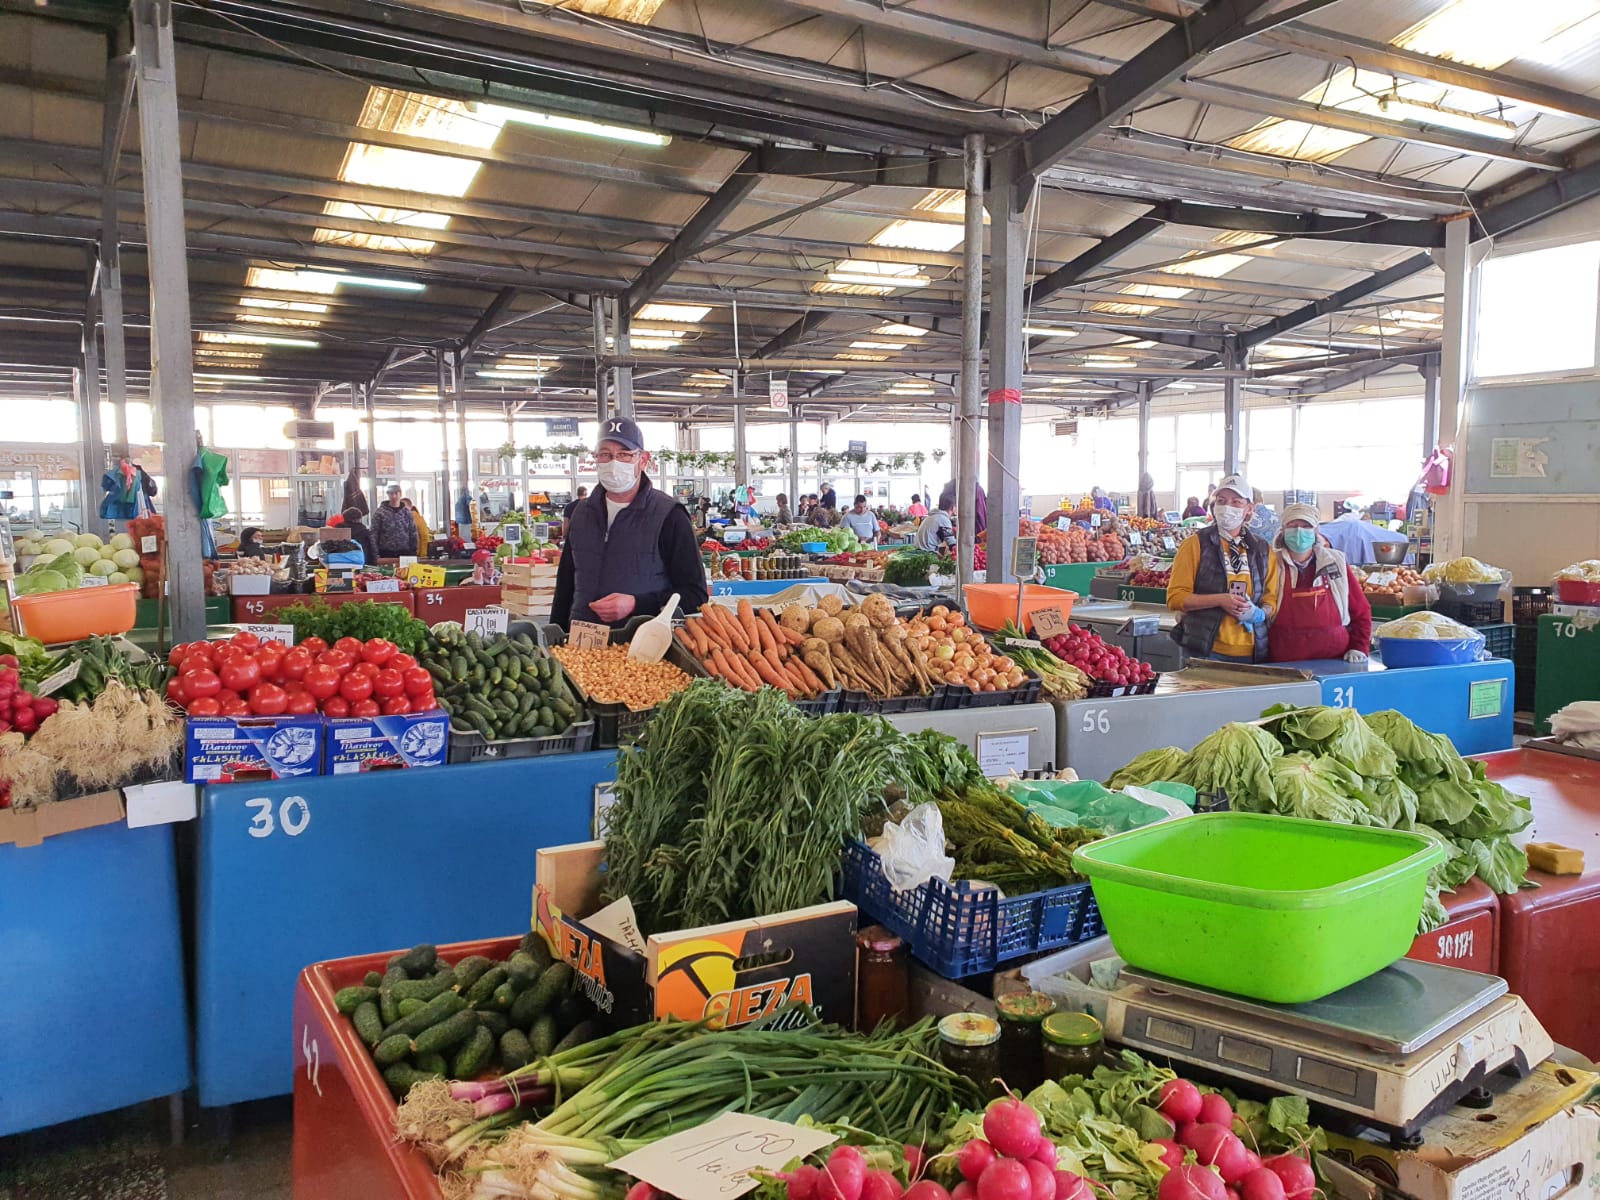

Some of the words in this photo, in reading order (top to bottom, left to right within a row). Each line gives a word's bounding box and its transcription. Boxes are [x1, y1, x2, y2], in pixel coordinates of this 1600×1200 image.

[1046, 567, 1056, 578] 19
[425, 593, 443, 606] 34
[1121, 589, 1135, 601] 20
[245, 600, 264, 614] 45
[1552, 621, 1576, 638] 70
[1333, 686, 1353, 708] 31
[1082, 709, 1110, 734] 56
[244, 795, 311, 838] 30
